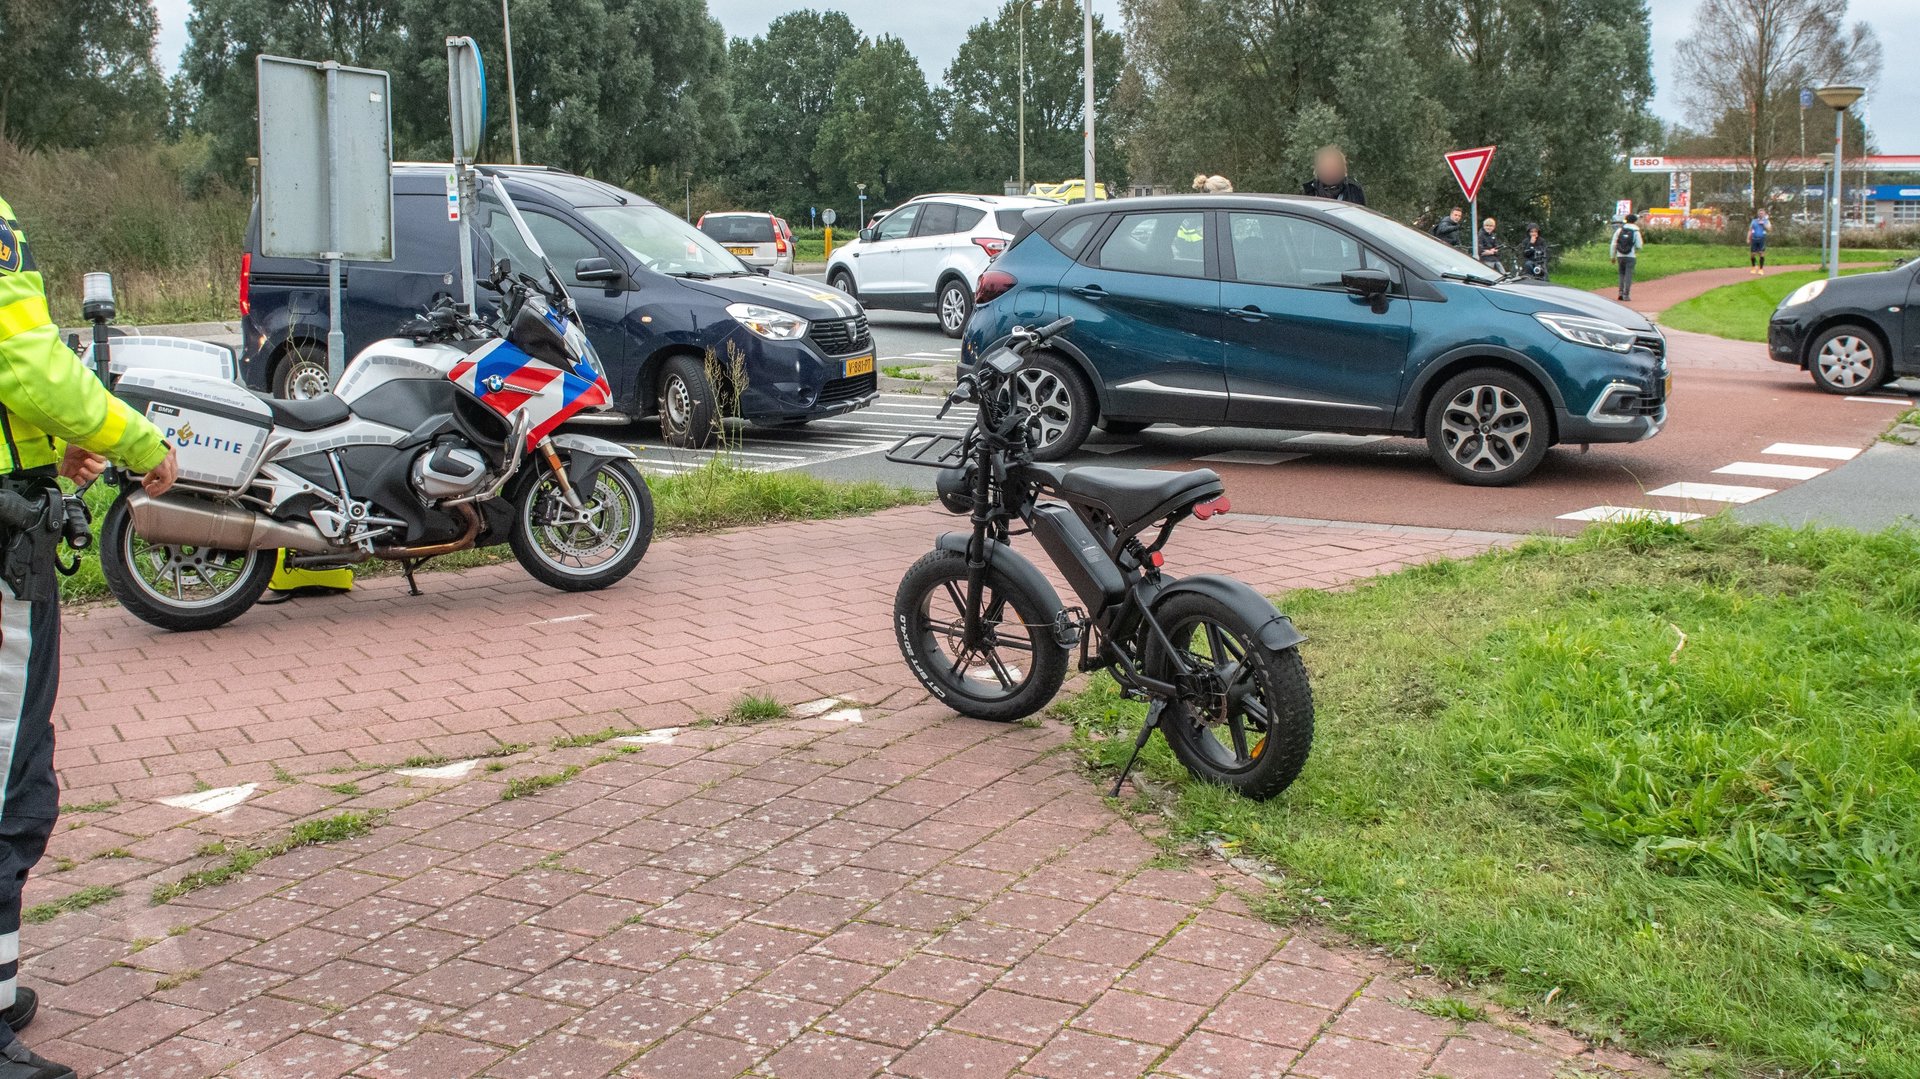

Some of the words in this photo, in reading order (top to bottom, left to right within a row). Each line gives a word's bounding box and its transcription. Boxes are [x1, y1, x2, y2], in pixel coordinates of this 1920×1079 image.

[158, 406, 174, 415] BMW
[166, 427, 243, 455] POLITIE
[911, 658, 928, 680] BFT
[926, 681, 946, 698] CST
